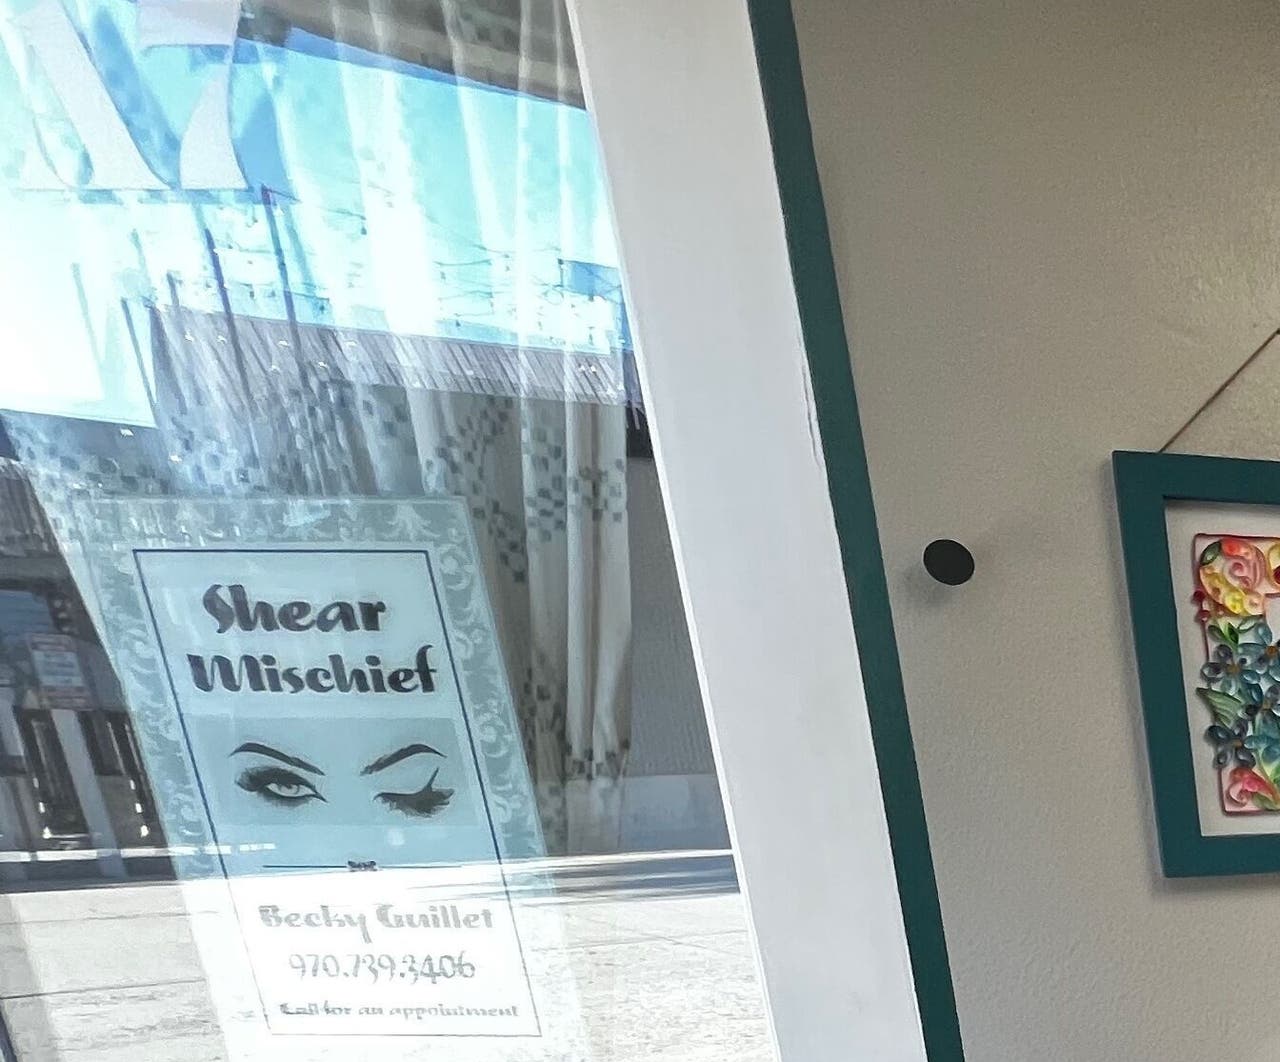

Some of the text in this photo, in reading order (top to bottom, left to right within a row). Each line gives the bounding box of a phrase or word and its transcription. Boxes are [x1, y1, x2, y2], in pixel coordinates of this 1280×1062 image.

[202, 583, 387, 634] Shear
[186, 644, 438, 694] Mischief
[258, 903, 494, 944] Becky Guillet
[288, 950, 476, 985] 970.739.3406
[323, 1000, 352, 1016] for
[358, 1006, 384, 1016] an
[388, 1003, 521, 1020] appointment
